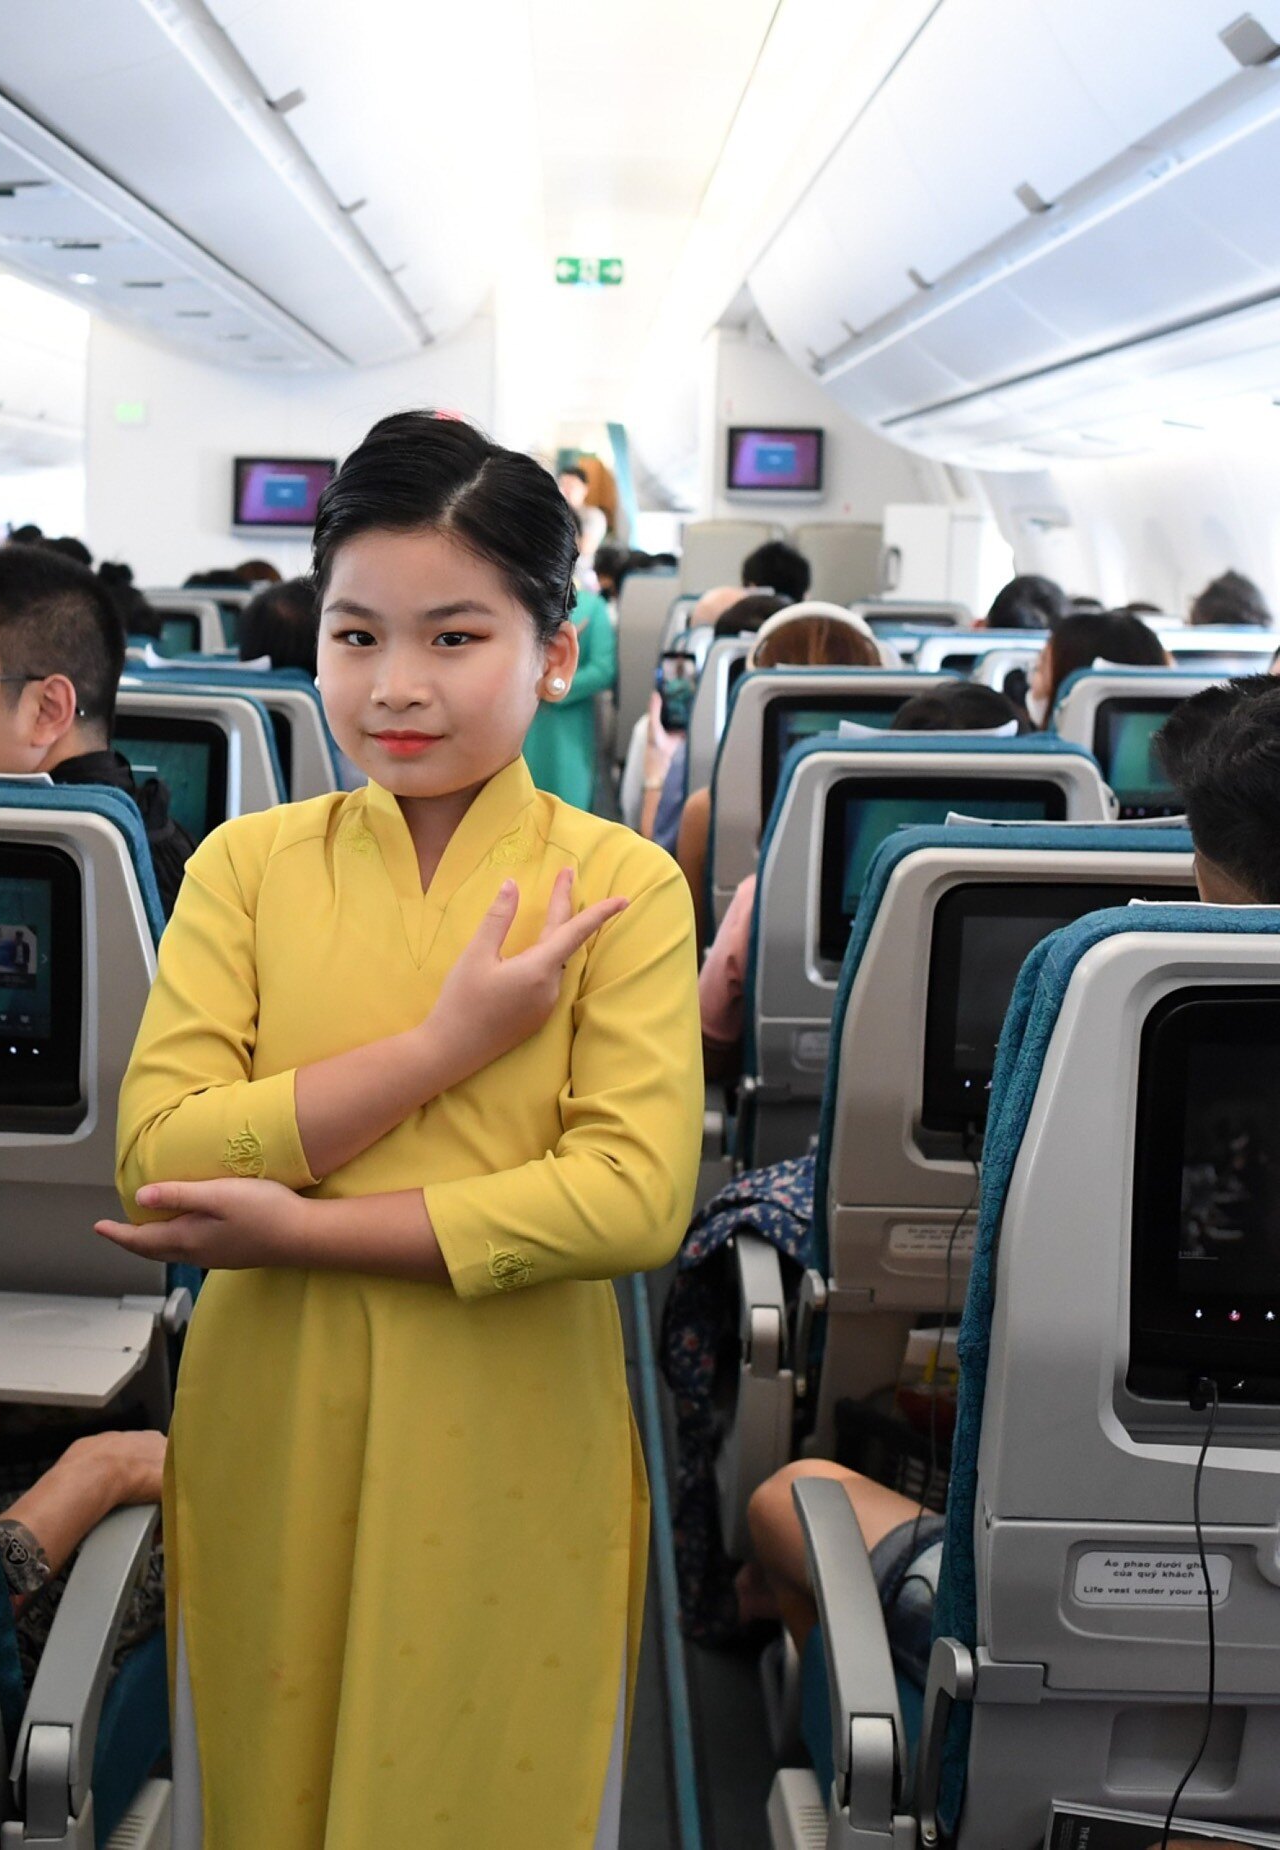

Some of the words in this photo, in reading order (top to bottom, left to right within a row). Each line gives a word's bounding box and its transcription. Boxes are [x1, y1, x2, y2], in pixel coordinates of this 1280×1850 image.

[1123, 1559, 1151, 1570] phao
[1161, 1569, 1195, 1579] khách
[1083, 1586, 1104, 1594] Life
[1107, 1587, 1131, 1595] vest
[1134, 1587, 1165, 1596] under
[1169, 1588, 1193, 1597] your
